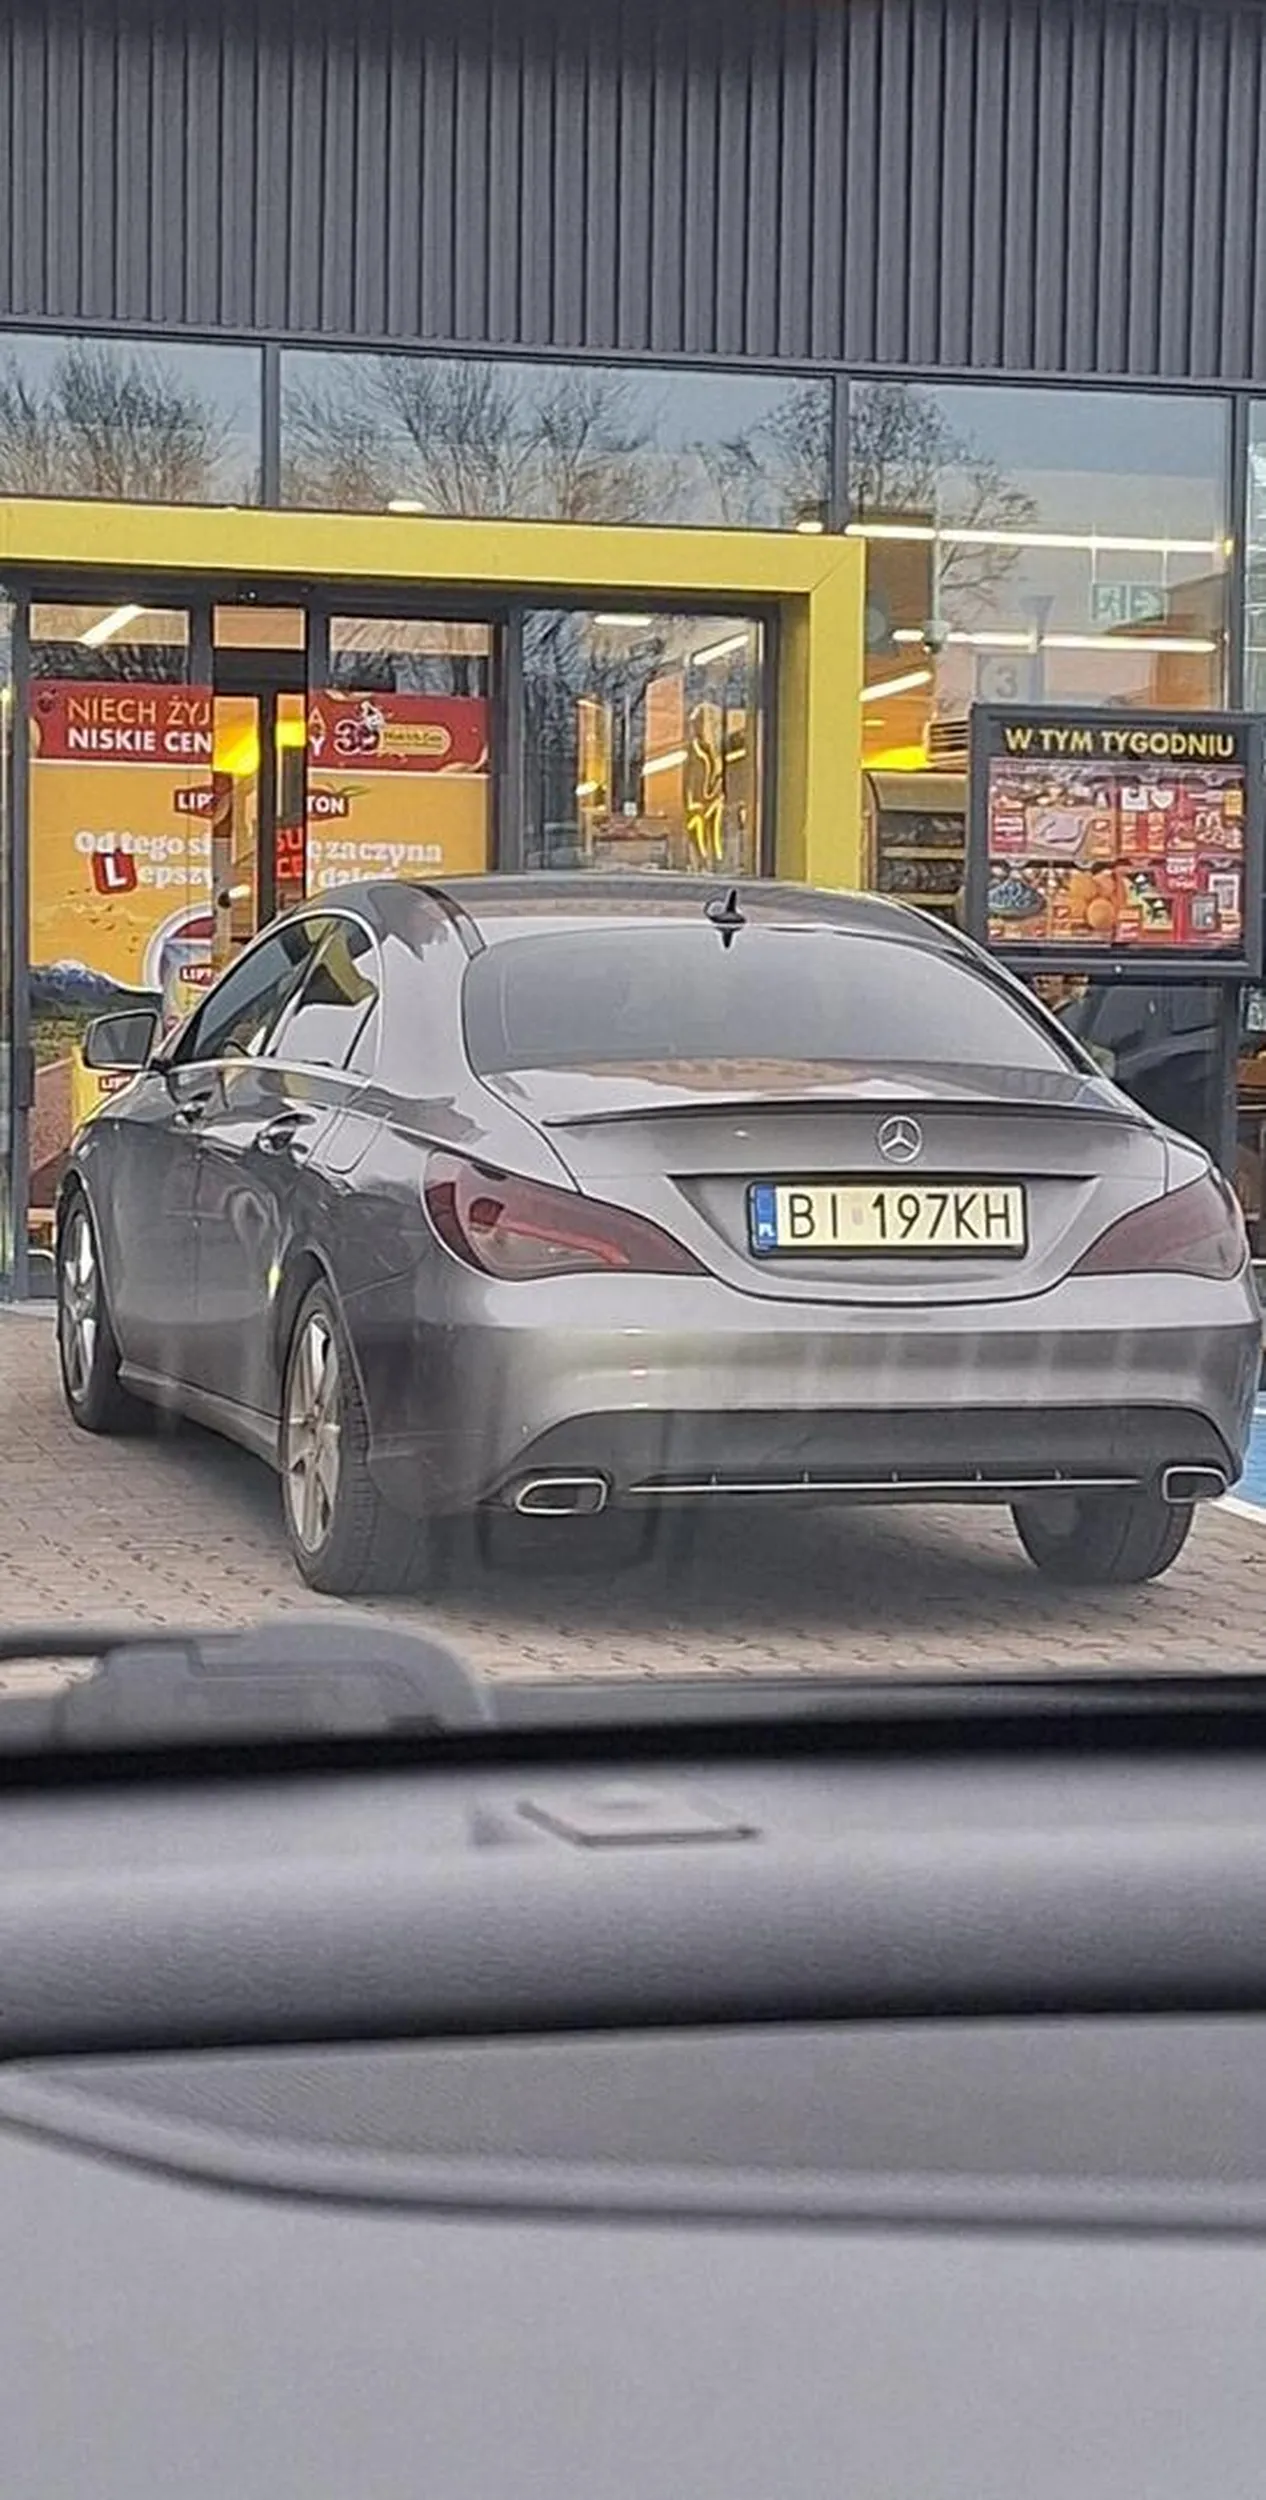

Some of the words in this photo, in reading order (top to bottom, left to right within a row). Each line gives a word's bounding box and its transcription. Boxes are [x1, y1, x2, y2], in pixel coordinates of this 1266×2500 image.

[996, 663, 1018, 699] 3
[68, 698, 156, 725] NIECH
[166, 695, 211, 726] ŻYJ
[68, 729, 156, 751] NISKIE
[164, 732, 212, 753] CEN
[1005, 729, 1033, 750] W
[1038, 730, 1092, 751] TYM
[1102, 732, 1234, 757] TYGODNIU
[74, 831, 117, 853] Od
[120, 832, 186, 862] tego
[325, 842, 442, 867] zaczyna
[788, 1195, 838, 1238] BI
[871, 1193, 1011, 1239] 197KH
